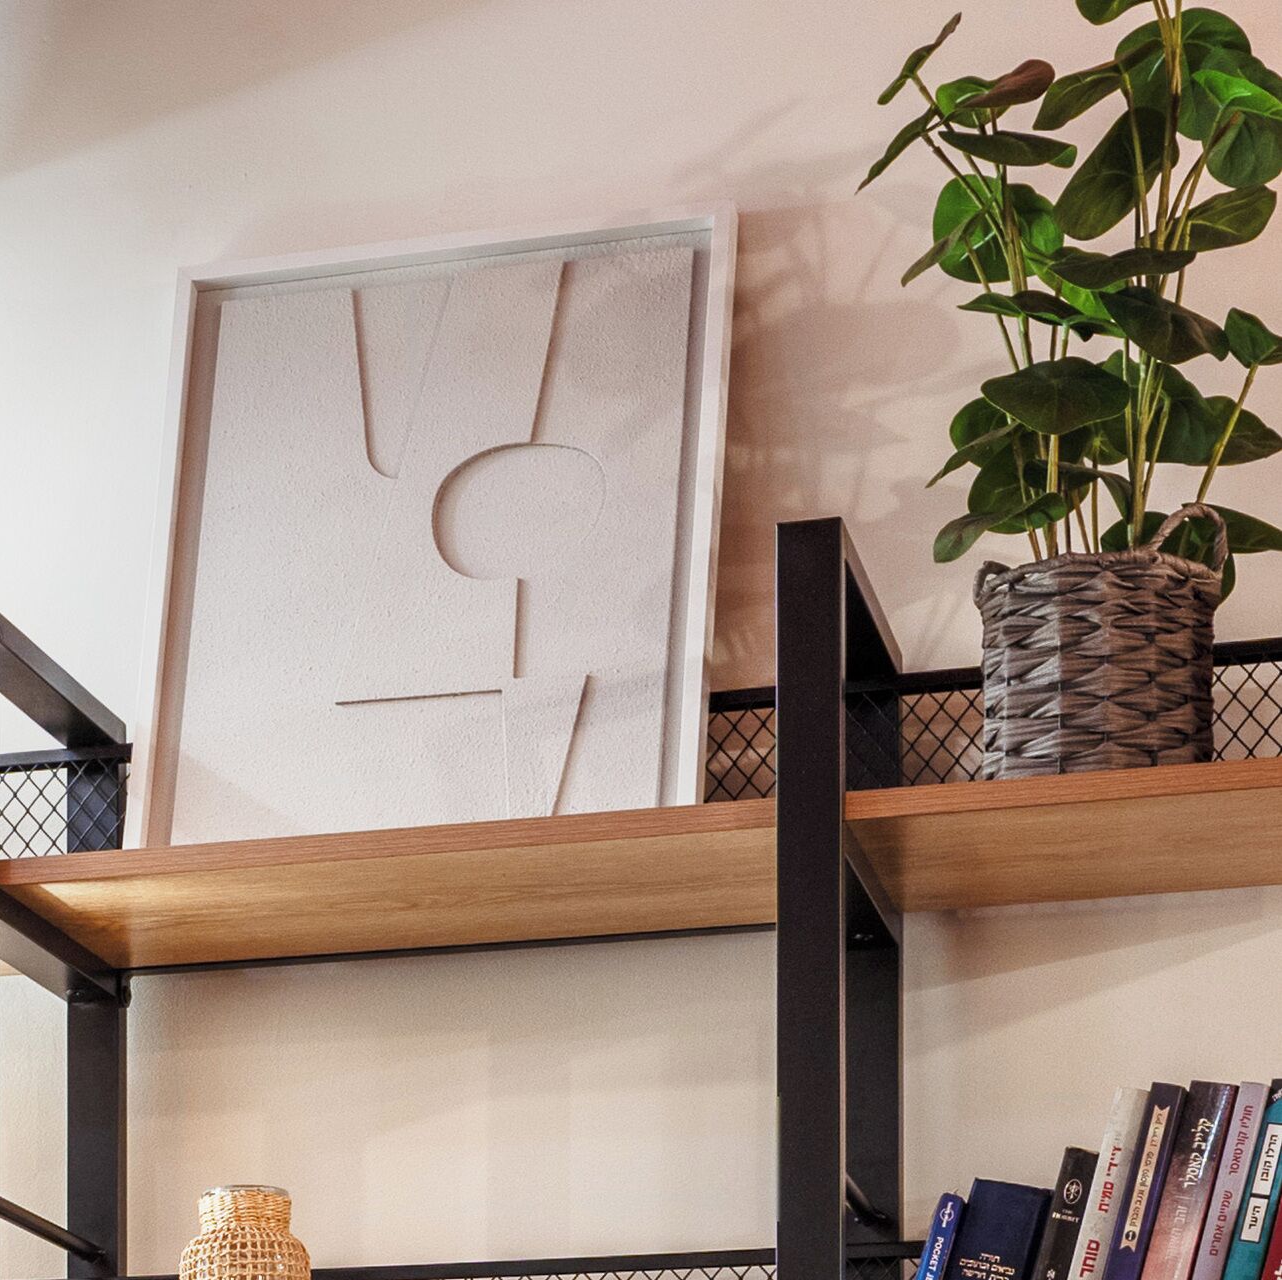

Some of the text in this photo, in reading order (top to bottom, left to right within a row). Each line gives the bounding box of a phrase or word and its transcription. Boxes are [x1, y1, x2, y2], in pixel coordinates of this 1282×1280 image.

[1179, 1118, 1214, 1188] קלייב קאסלר
[1229, 1104, 1253, 1175] חוליו קורטאסר
[1261, 1134, 1278, 1182] הרלן קובן
[1097, 1180, 1114, 1213] סמית
[1209, 1189, 1233, 1256] שמיים אחרים
[1248, 1206, 1261, 1229] היער
[929, 1235, 944, 1271] POCKET
[979, 1253, 1000, 1263] תורה
[1080, 1238, 1100, 1279] סוחר
